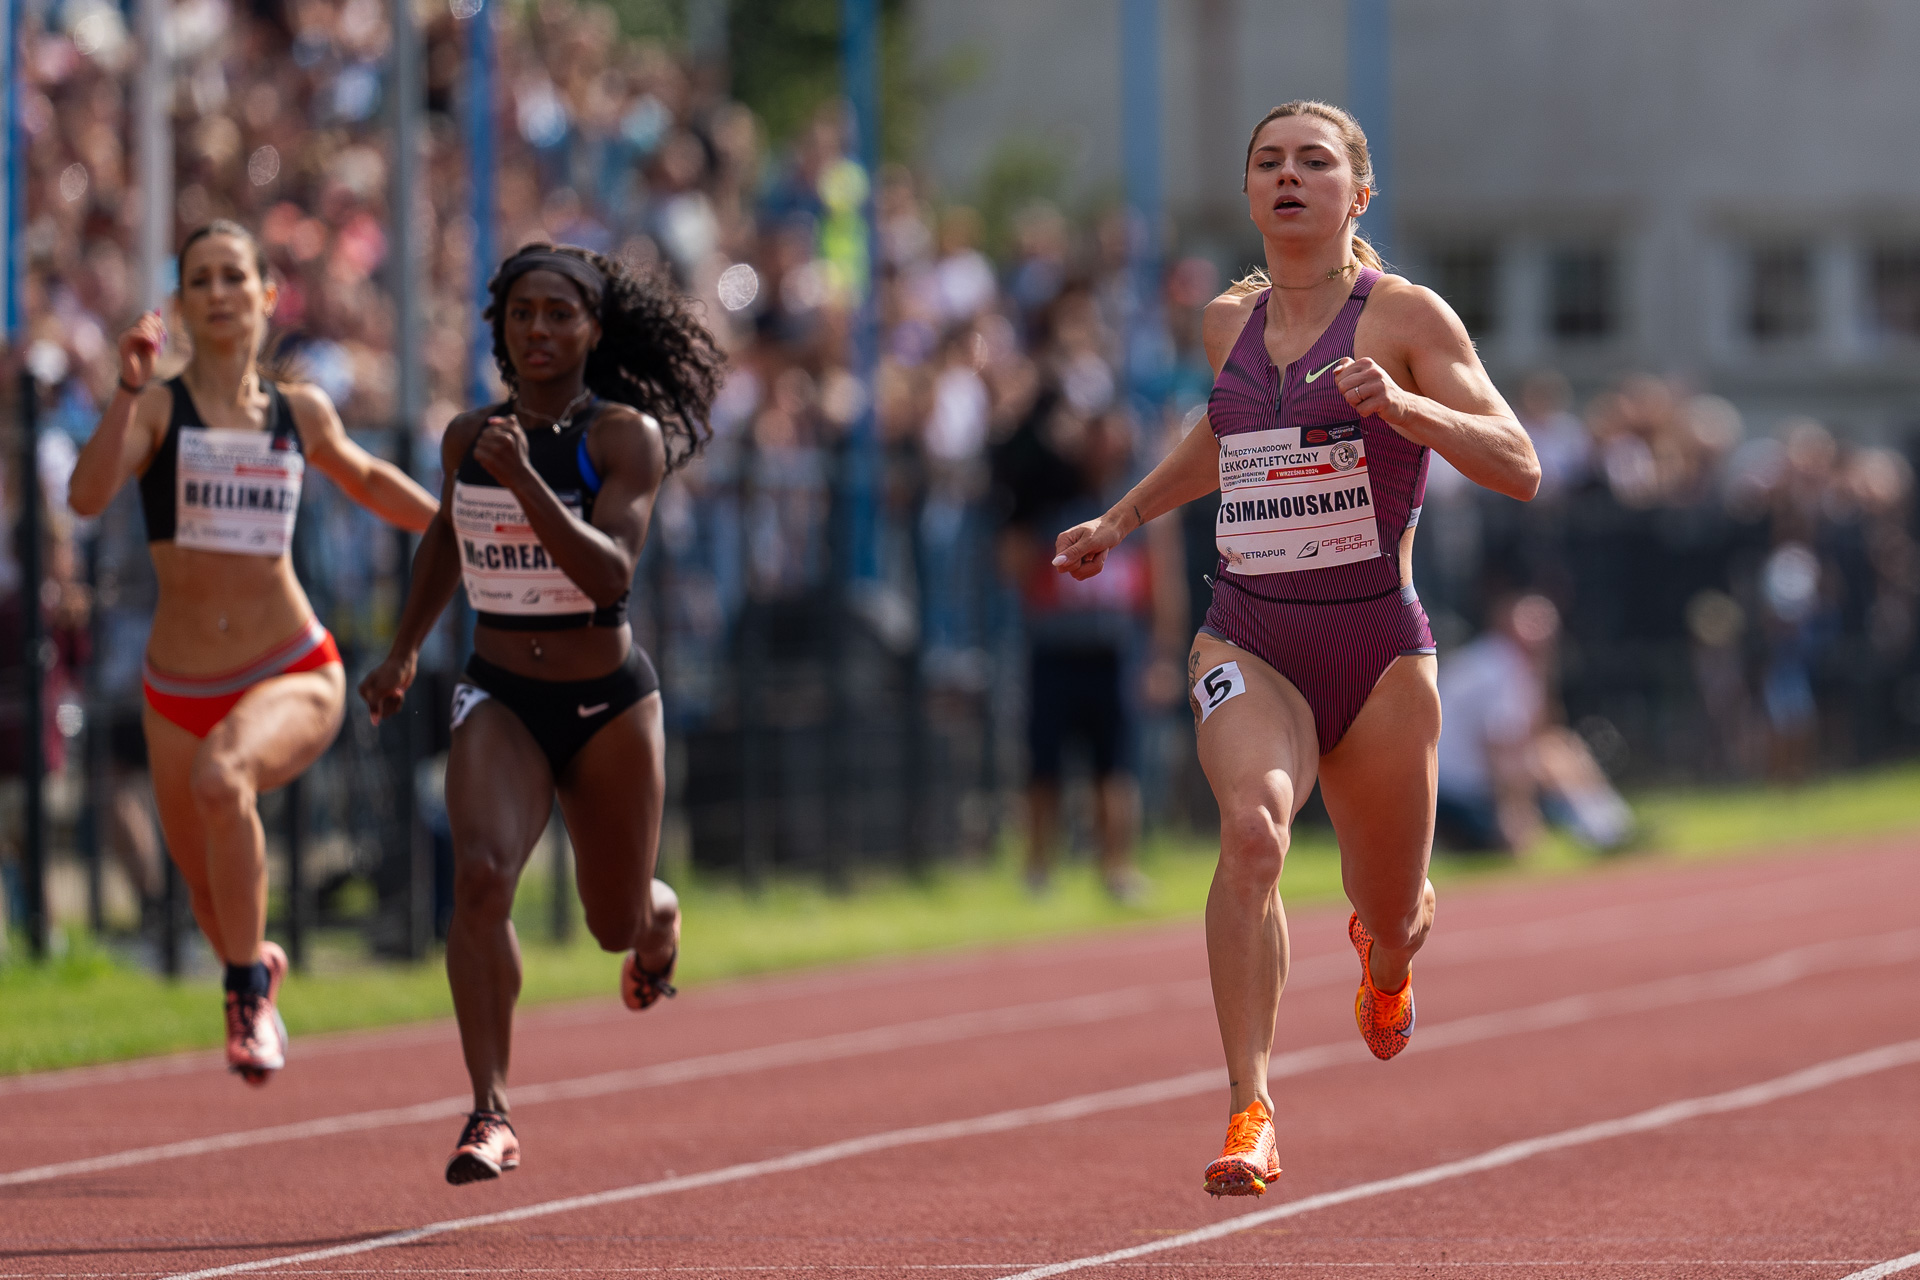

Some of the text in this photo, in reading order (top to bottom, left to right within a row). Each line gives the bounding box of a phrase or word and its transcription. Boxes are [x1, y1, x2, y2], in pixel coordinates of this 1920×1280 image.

[1228, 443, 1292, 458] MIĘDZYNARODOWY
[1221, 452, 1319, 473] LEKKOATLETYCZNY
[1279, 469, 1305, 477] WRZEŚNIA
[1219, 486, 1370, 524] TSIMANOUSKAYA
[1241, 548, 1286, 560] TETRAPUR
[1335, 538, 1375, 553] SPORT
[464, 540, 560, 570] McCREA
[1203, 666, 1233, 709] 5
